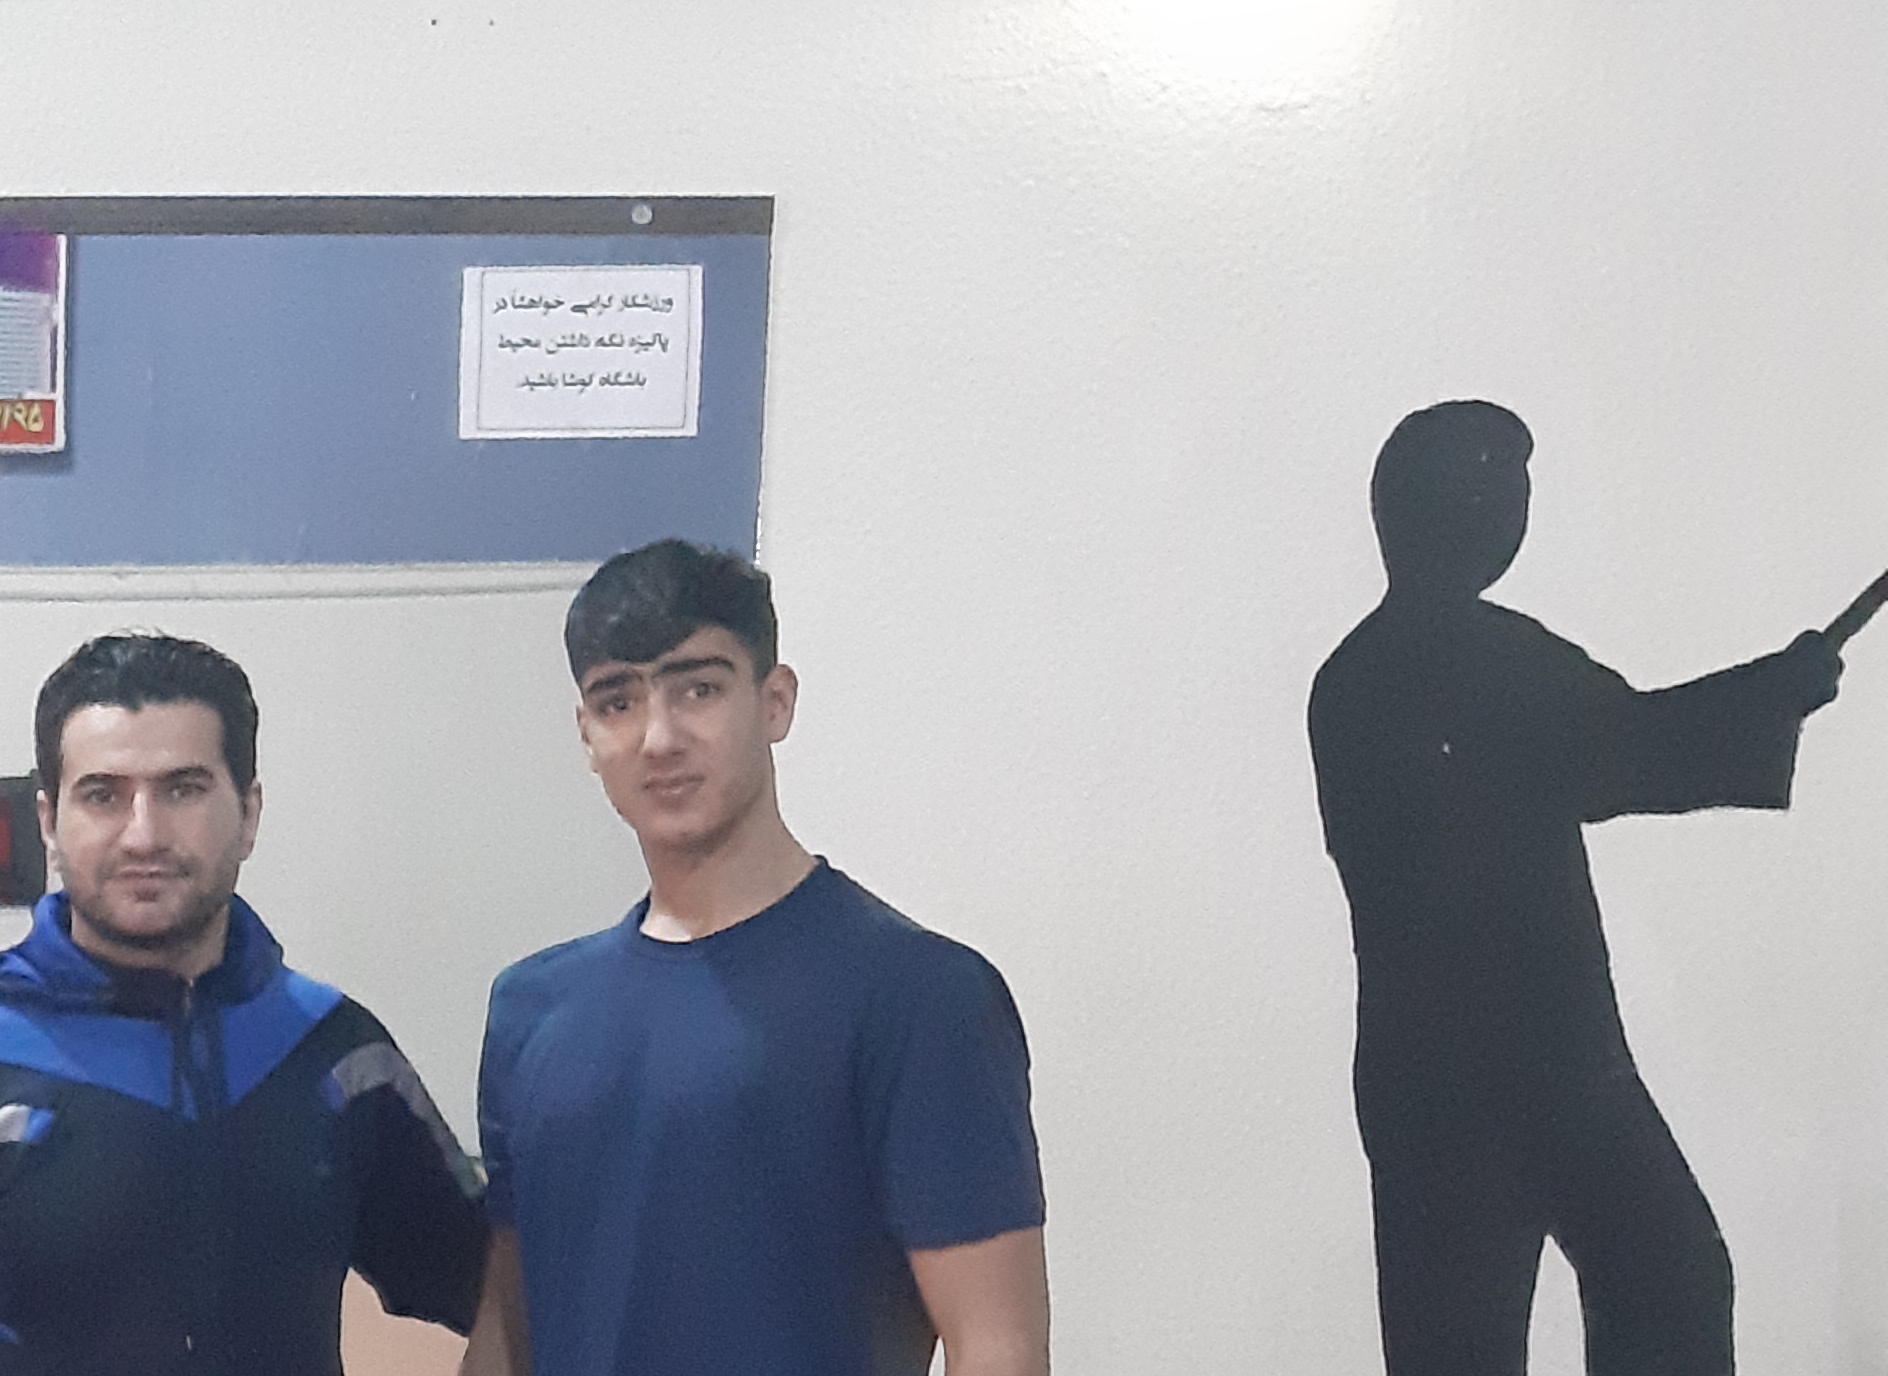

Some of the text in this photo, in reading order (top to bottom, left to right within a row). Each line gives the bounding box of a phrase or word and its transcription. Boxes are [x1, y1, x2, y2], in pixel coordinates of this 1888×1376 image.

[492, 296, 509, 316] در
[570, 294, 614, 317] گرامی
[497, 333, 670, 355] پاکیزه نگه داشتن محیط
[562, 371, 597, 393] کوشا
[598, 370, 648, 390] باشگاه
